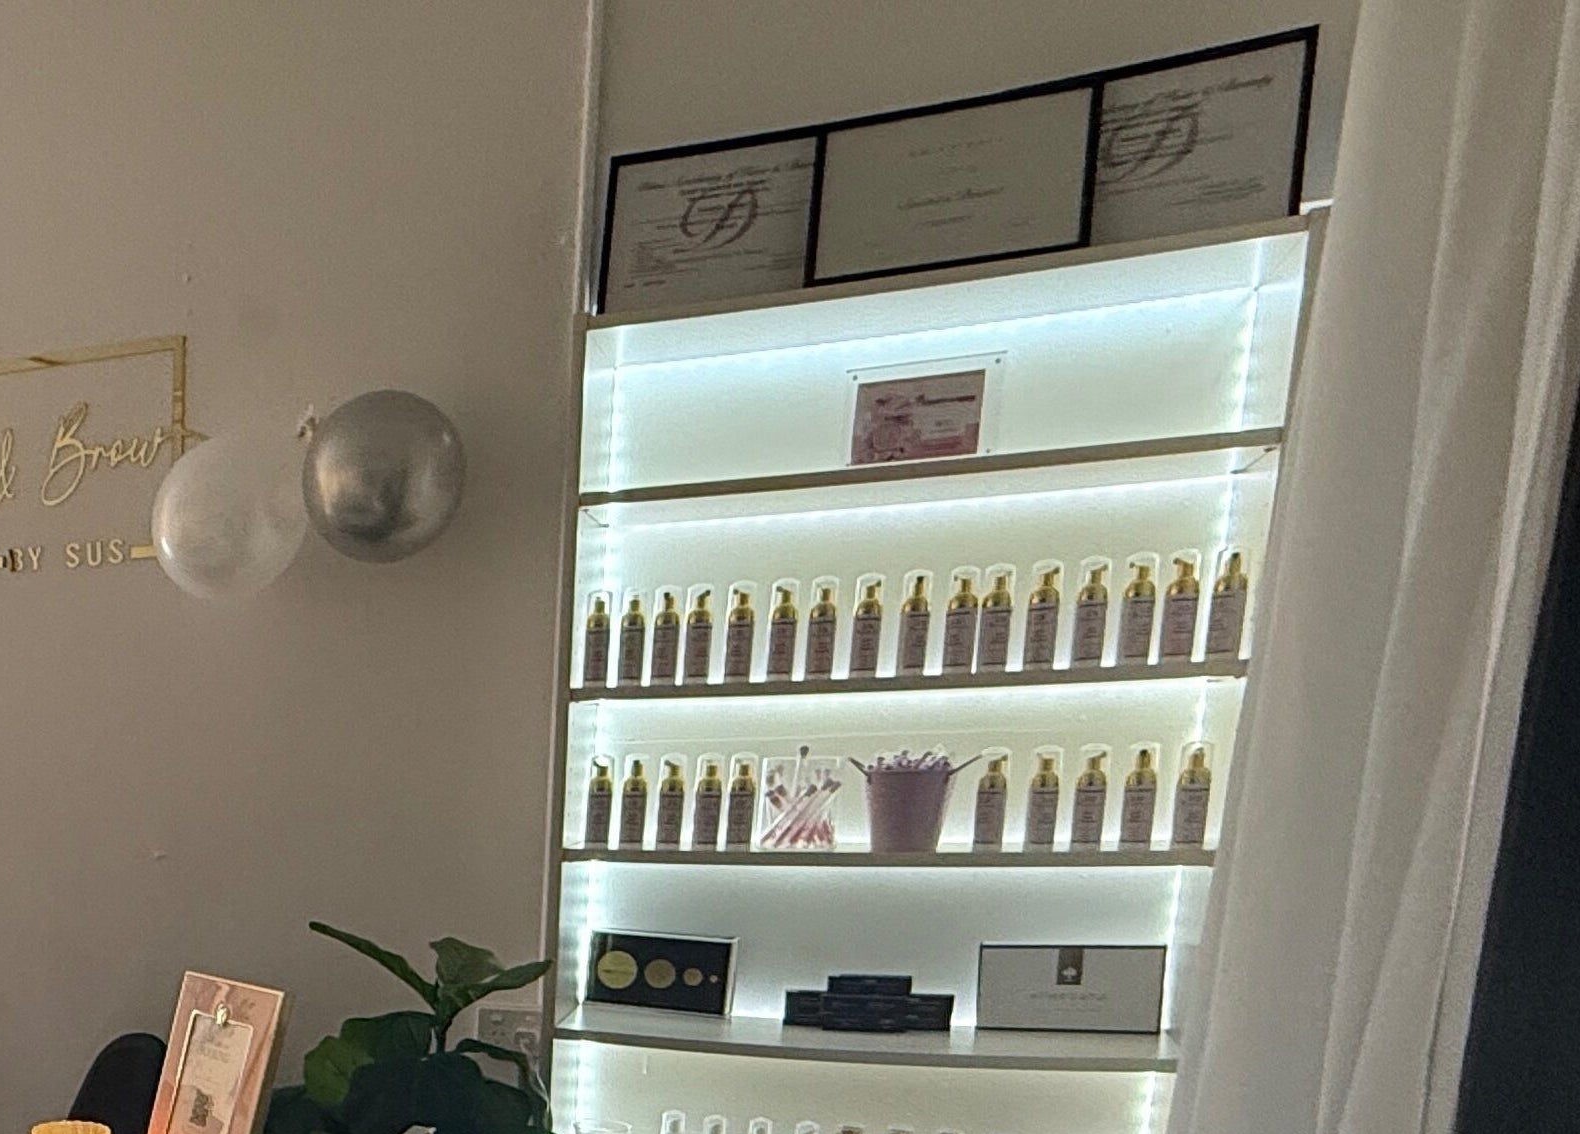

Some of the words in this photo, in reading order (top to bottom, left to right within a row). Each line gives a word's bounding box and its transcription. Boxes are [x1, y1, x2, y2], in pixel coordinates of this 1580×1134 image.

[40, 401, 166, 507] Brow
[8, 546, 42, 574] BY
[66, 537, 127, 570] SUS
